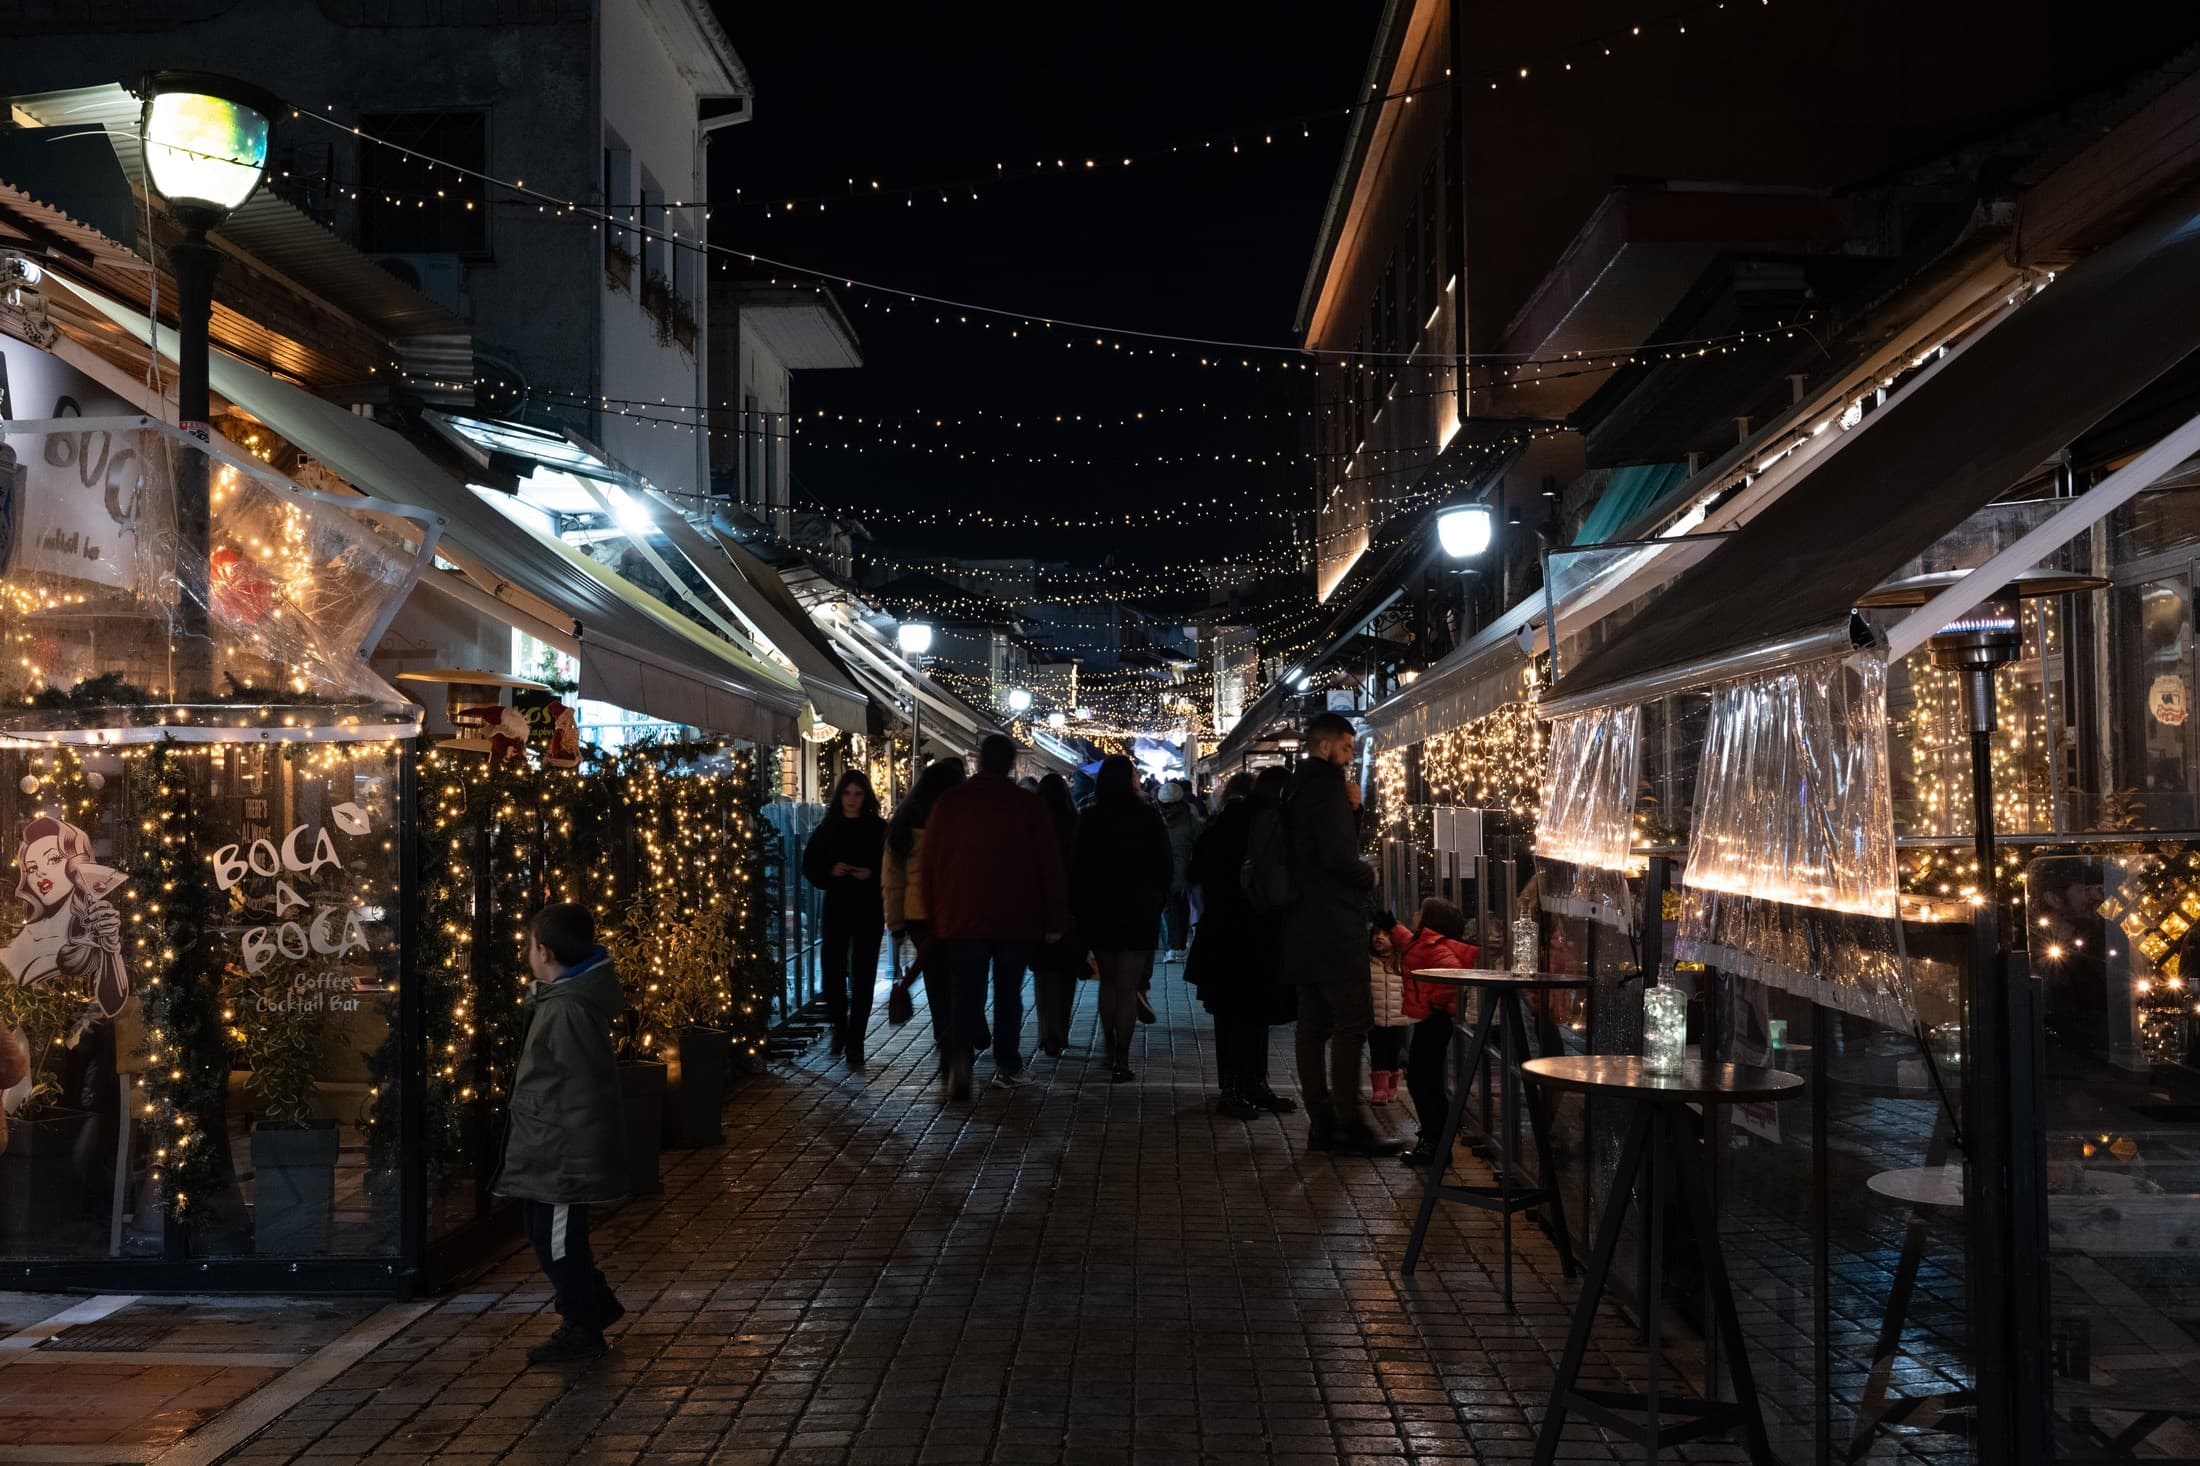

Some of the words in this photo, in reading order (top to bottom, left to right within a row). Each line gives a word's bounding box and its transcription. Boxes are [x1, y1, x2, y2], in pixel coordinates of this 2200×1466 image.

[212, 823, 343, 891] BOCA
[276, 879, 310, 917] A
[241, 906, 371, 974] BOCA
[294, 972, 351, 991] Coffee
[255, 991, 324, 1012] Cocktail
[329, 995, 361, 1012] Bar
